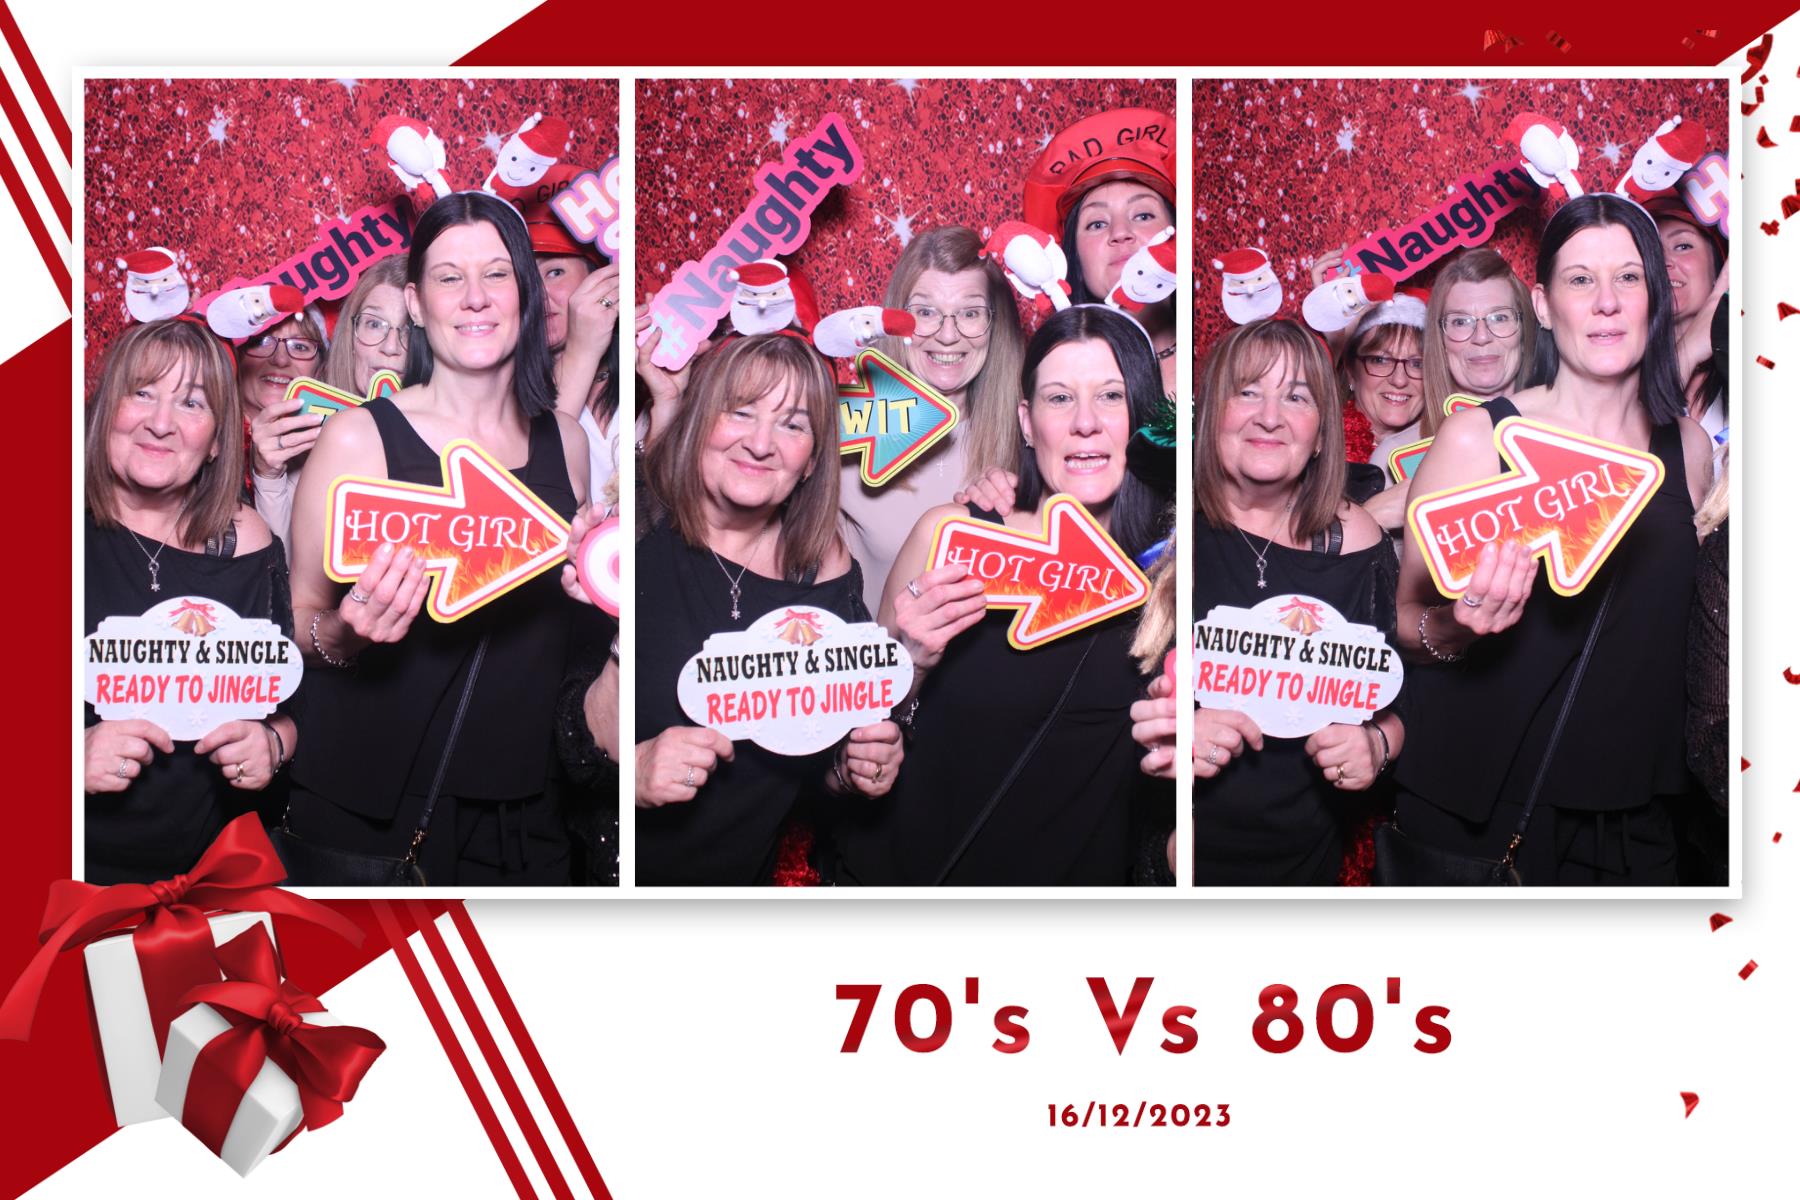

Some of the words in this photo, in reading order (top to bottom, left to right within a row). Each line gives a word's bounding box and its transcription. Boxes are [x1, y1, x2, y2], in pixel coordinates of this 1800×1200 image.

[1117, 124, 1169, 149] GIRL
[234, 205, 411, 297] ughty
[345, 509, 442, 544] HOT
[448, 514, 541, 555] GIRL
[1436, 496, 1524, 556] HOT
[1534, 463, 1632, 522] GIRL
[947, 546, 1036, 583] HOT
[1038, 560, 1117, 600] GIRL
[89, 639, 191, 664] NAUGHTY
[195, 639, 211, 665] &
[215, 640, 290, 664] SINGLE
[696, 650, 799, 683] NAUGHTY
[805, 649, 820, 675] &
[824, 642, 898, 672] SINGLE
[1195, 625, 1296, 661] NAUGHTY
[1299, 639, 1315, 664] &
[1318, 641, 1392, 673] SINGLE
[96, 673, 171, 704] READY
[175, 674, 204, 704] TO
[207, 674, 281, 704] JINGLE
[706, 687, 782, 725] READY
[786, 686, 815, 717] TO
[820, 679, 893, 714] JINGLE
[1198, 660, 1273, 698] READY
[1276, 671, 1304, 701] TO
[1306, 675, 1381, 710] JINGLE
